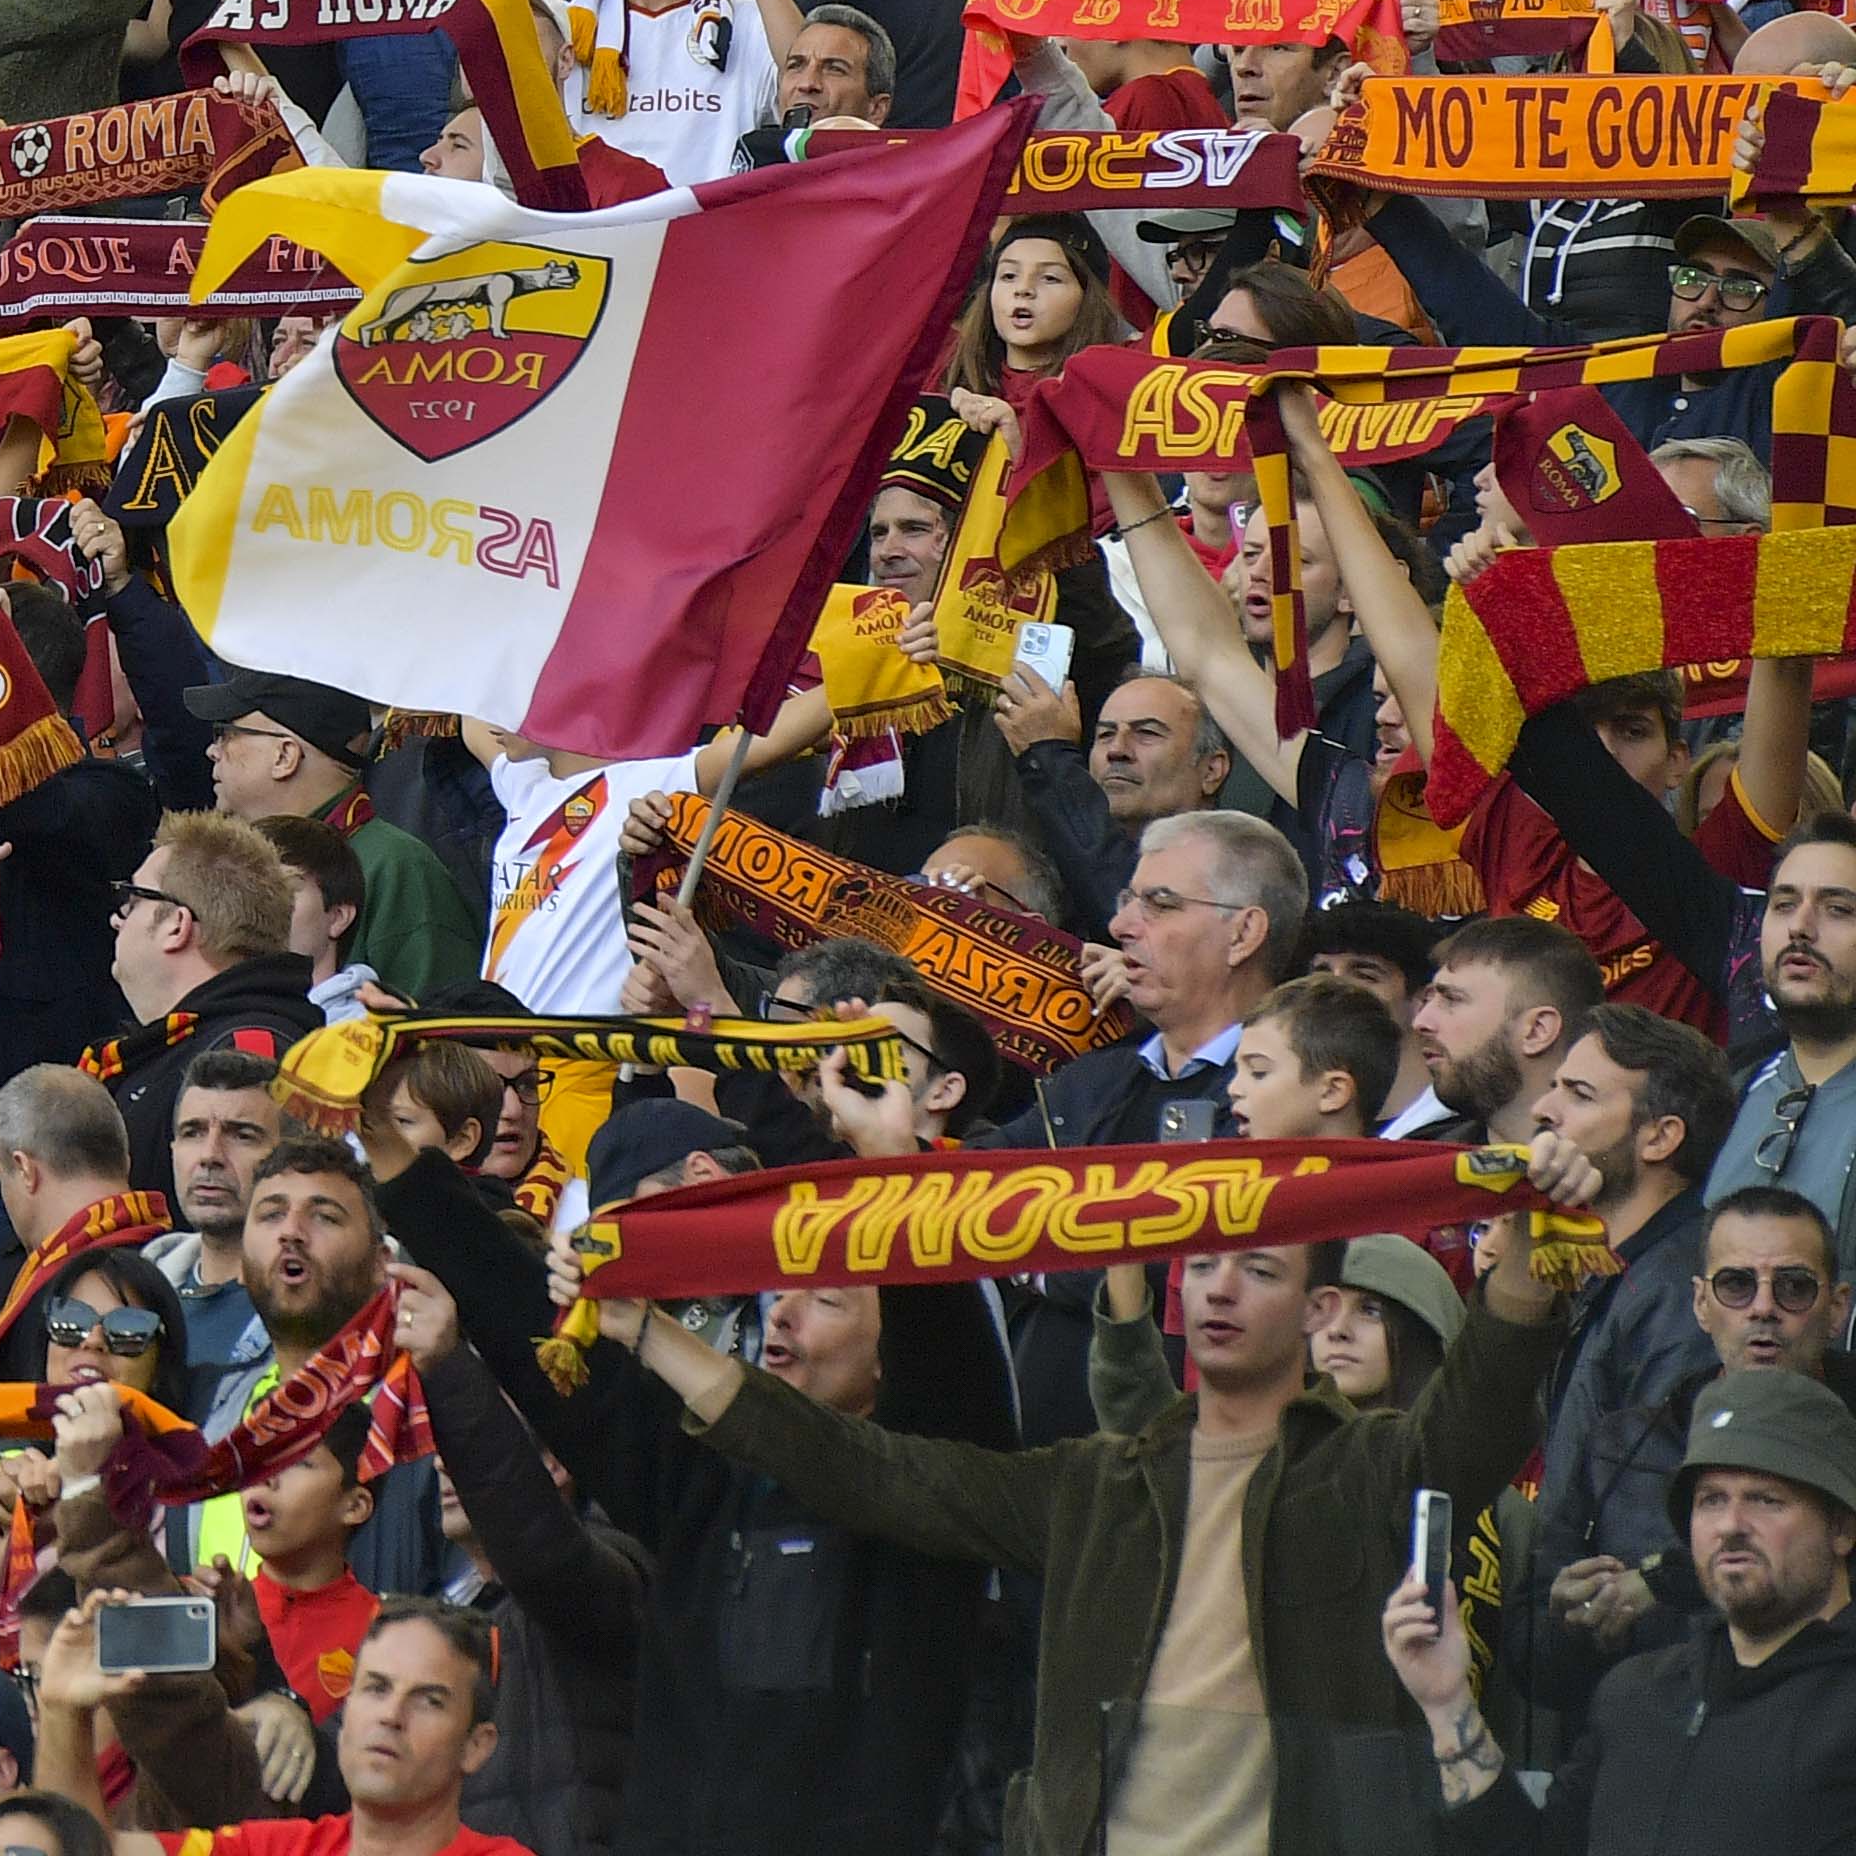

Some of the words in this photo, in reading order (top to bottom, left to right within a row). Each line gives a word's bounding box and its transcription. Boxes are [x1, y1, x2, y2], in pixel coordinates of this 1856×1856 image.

[65, 104, 217, 174] ROMA
[1397, 84, 1492, 168] MO'
[1504, 86, 1570, 168] TE
[140, 155, 197, 177] ONORE
[1538, 457, 1581, 509] ROMA
[773, 1156, 1280, 1276] ASROMA
